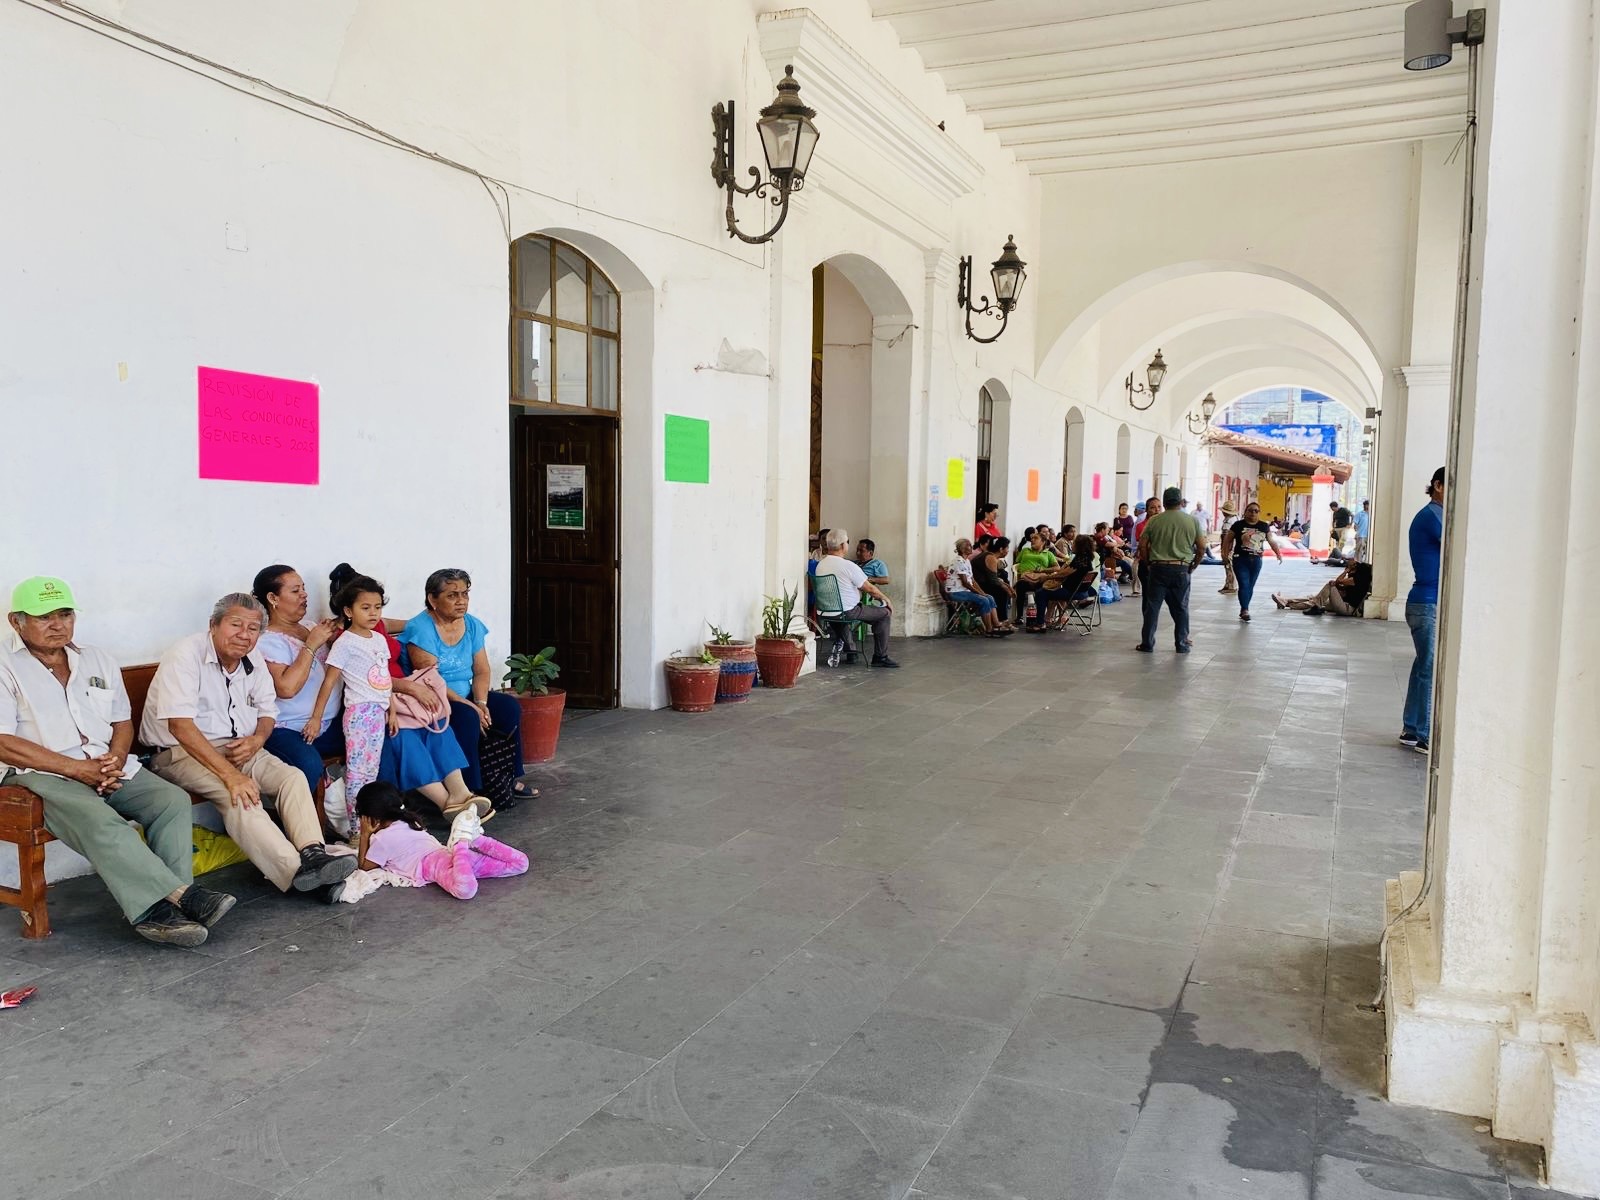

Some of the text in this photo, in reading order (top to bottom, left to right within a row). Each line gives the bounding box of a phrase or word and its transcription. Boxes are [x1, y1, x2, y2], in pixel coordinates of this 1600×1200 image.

[203, 378, 302, 408] REVISIÓN DE
[203, 404, 315, 434] LAS CONDICIONES
[202, 425, 282, 449] GENERALES
